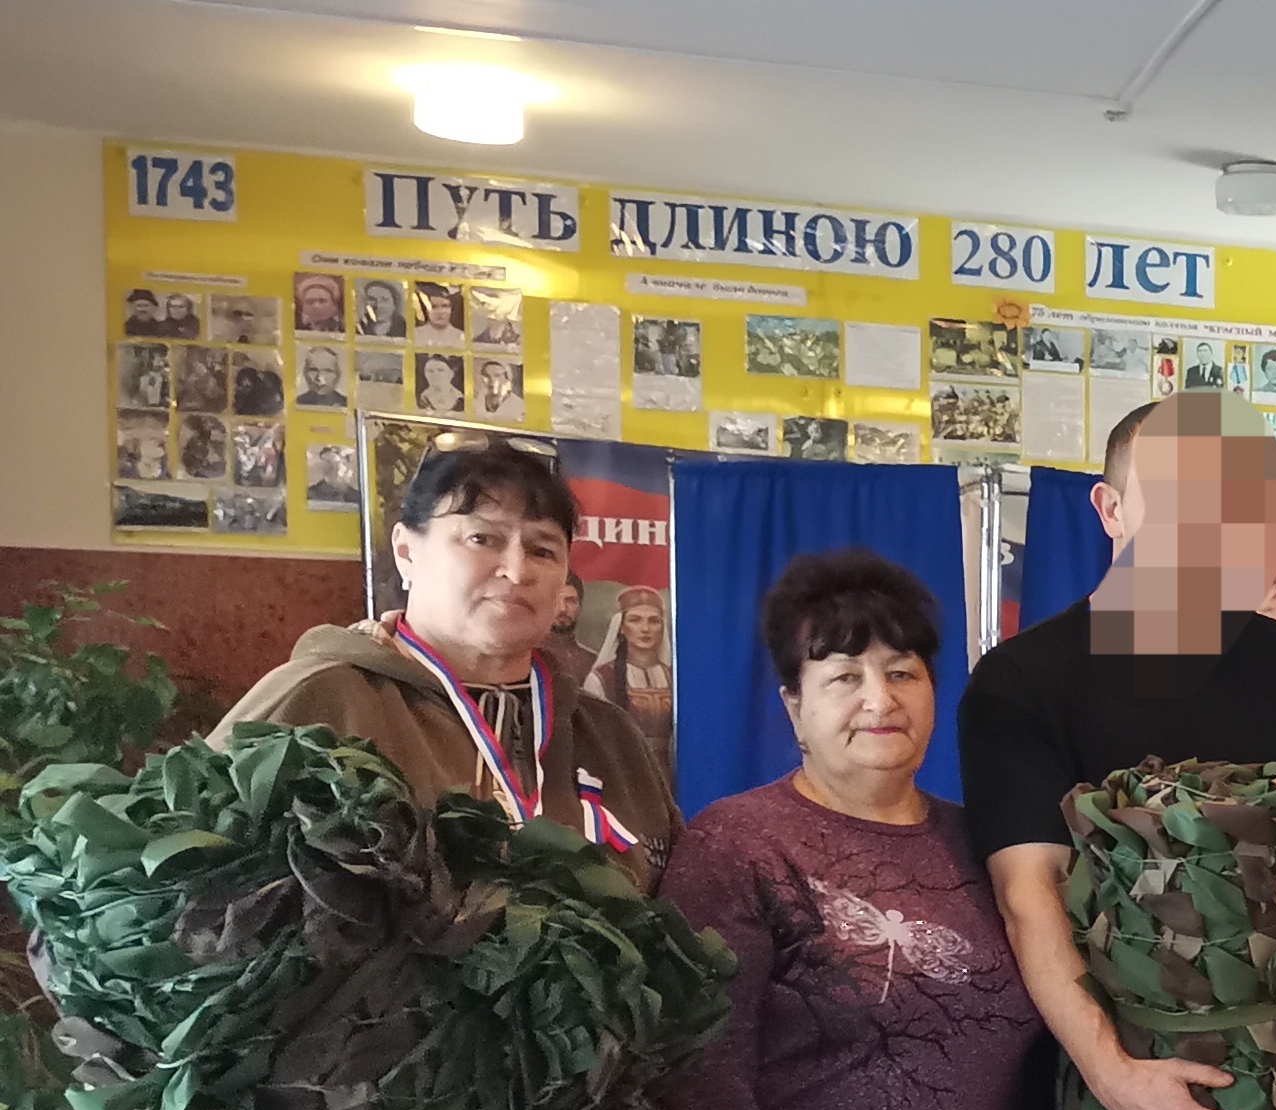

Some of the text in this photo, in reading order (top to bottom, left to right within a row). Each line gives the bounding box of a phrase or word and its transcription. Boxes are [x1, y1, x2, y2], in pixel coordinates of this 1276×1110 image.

[131, 154, 235, 211] 1743
[373, 172, 1211, 298] ПУТЬ ДЛИНОЮ 280 лет
